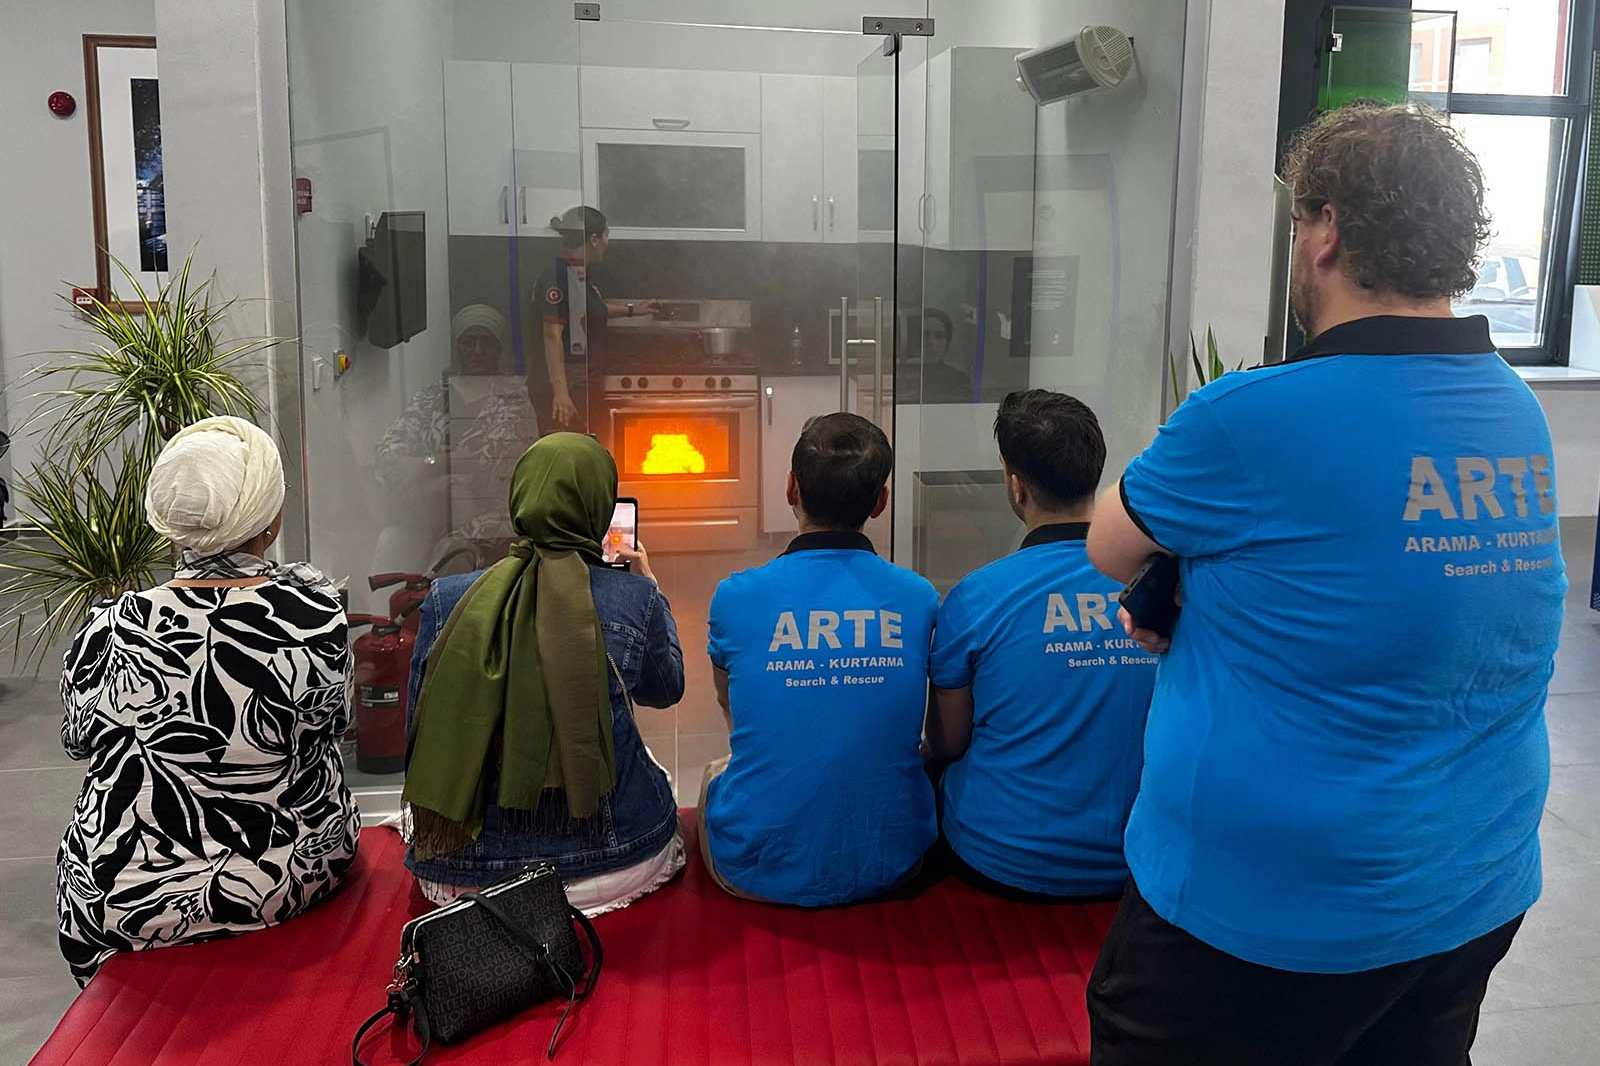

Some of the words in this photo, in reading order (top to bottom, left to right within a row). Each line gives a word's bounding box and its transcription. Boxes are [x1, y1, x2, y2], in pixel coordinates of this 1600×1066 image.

[1402, 454, 1555, 521] ARTE
[1404, 535, 1481, 553] ARAMA
[1444, 561, 1497, 577] Search
[1501, 559, 1511, 573] &
[1514, 557, 1553, 571] Resc
[768, 609, 903, 652] ARTE
[1045, 641, 1093, 653] ARAMA
[766, 659, 815, 672] ARAMA
[829, 657, 904, 669] KURTARMA
[1068, 656, 1105, 668] Search
[1109, 656, 1117, 665] &
[1121, 655, 1159, 665] Rescue
[785, 676, 826, 688] Search
[831, 676, 839, 685] &
[844, 675, 885, 685] Rescue
